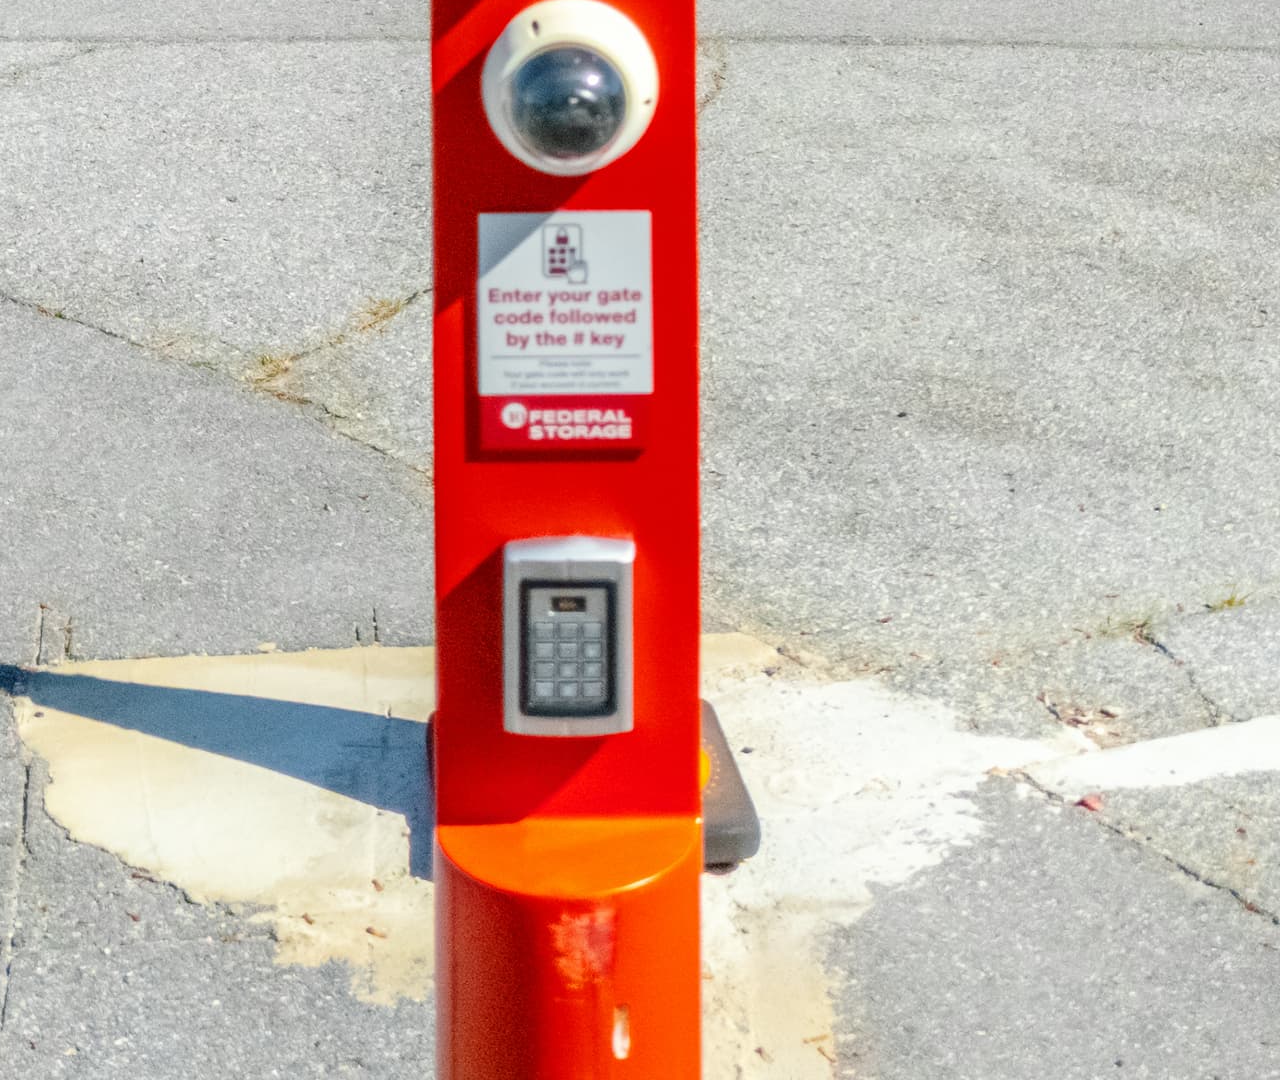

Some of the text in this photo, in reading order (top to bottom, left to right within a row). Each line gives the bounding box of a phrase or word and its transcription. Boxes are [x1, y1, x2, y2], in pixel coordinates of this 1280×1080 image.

[488, 288, 642, 307] Enter your gate
[494, 308, 636, 325] code followed
[506, 330, 625, 350] by the # key
[528, 408, 632, 424] FEDERAL
[528, 423, 632, 440] STORAGE
